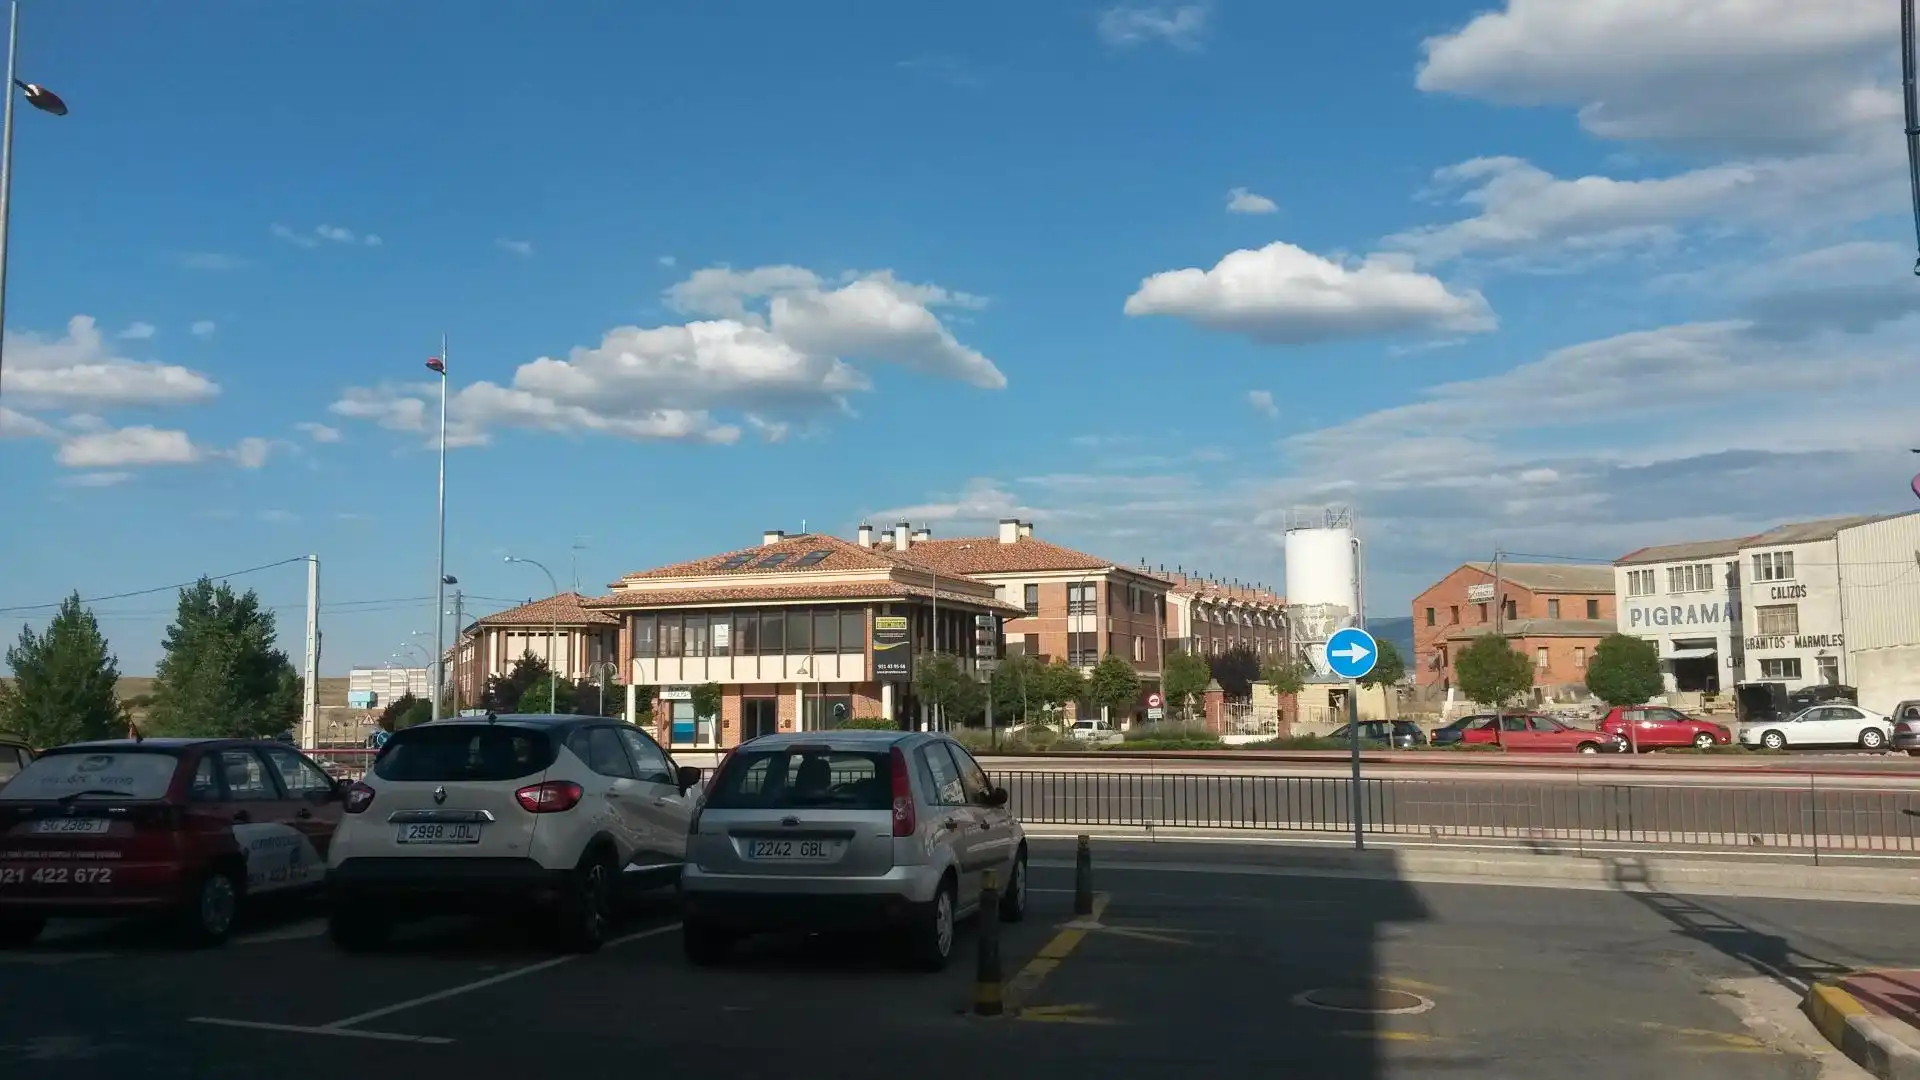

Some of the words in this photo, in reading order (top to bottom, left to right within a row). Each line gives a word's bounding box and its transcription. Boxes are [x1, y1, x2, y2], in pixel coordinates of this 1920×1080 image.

[1771, 585, 1807, 600] CALIZOS
[1630, 601, 1742, 628] PIGRAMA
[1744, 636, 1786, 650] GRANITOS
[1794, 634, 1844, 648] MARMOLES
[409, 826, 444, 839] 2998
[449, 825, 474, 839] JDL
[756, 842, 792, 856] 2242
[800, 842, 827, 856] GBL
[32, 868, 68, 884] 422
[74, 868, 112, 884] 672
